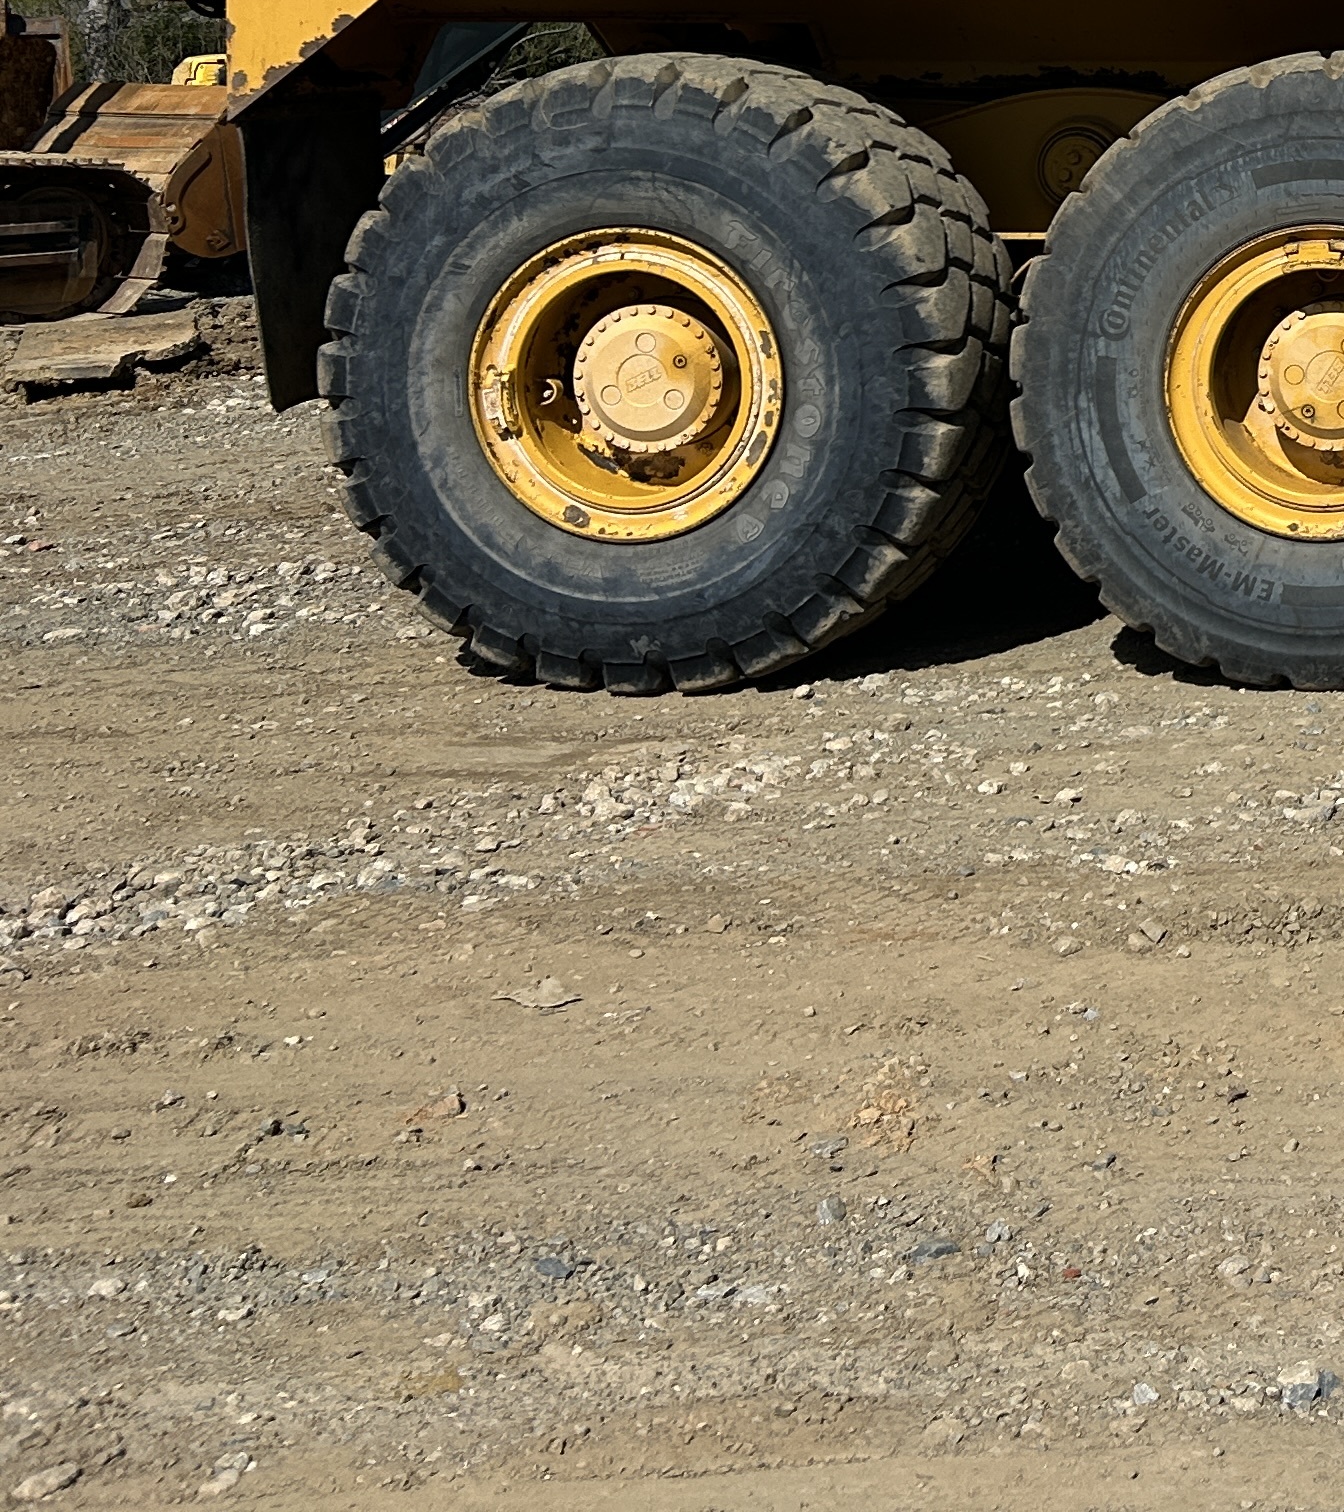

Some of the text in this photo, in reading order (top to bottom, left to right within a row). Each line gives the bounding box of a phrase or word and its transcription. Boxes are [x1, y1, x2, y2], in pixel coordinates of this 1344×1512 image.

[1098, 187, 1217, 341] Continental
[714, 219, 826, 510] Firestone
[1141, 507, 1276, 602] EM-Master
